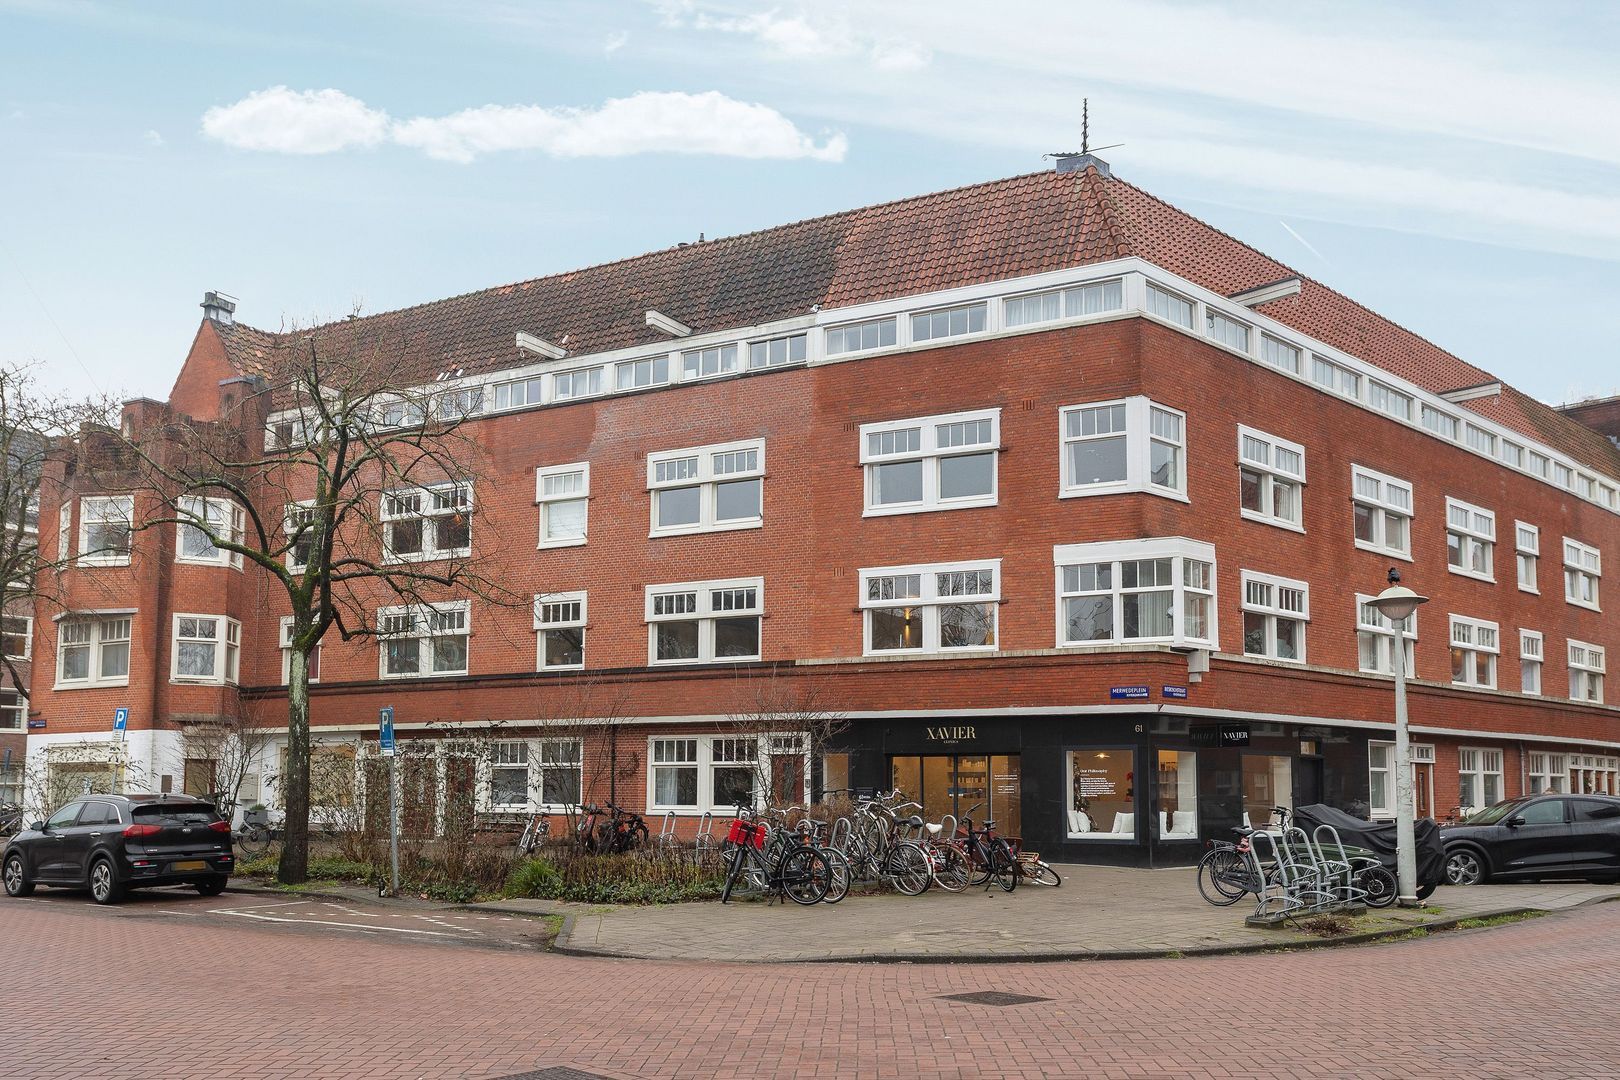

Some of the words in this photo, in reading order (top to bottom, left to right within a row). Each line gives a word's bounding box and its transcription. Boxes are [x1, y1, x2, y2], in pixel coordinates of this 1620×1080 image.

[116, 711, 125, 728] P
[382, 711, 389, 733] P
[926, 726, 976, 740] XAVIER
[1134, 724, 1143, 733] 61
[1223, 731, 1248, 739] XAVIER
